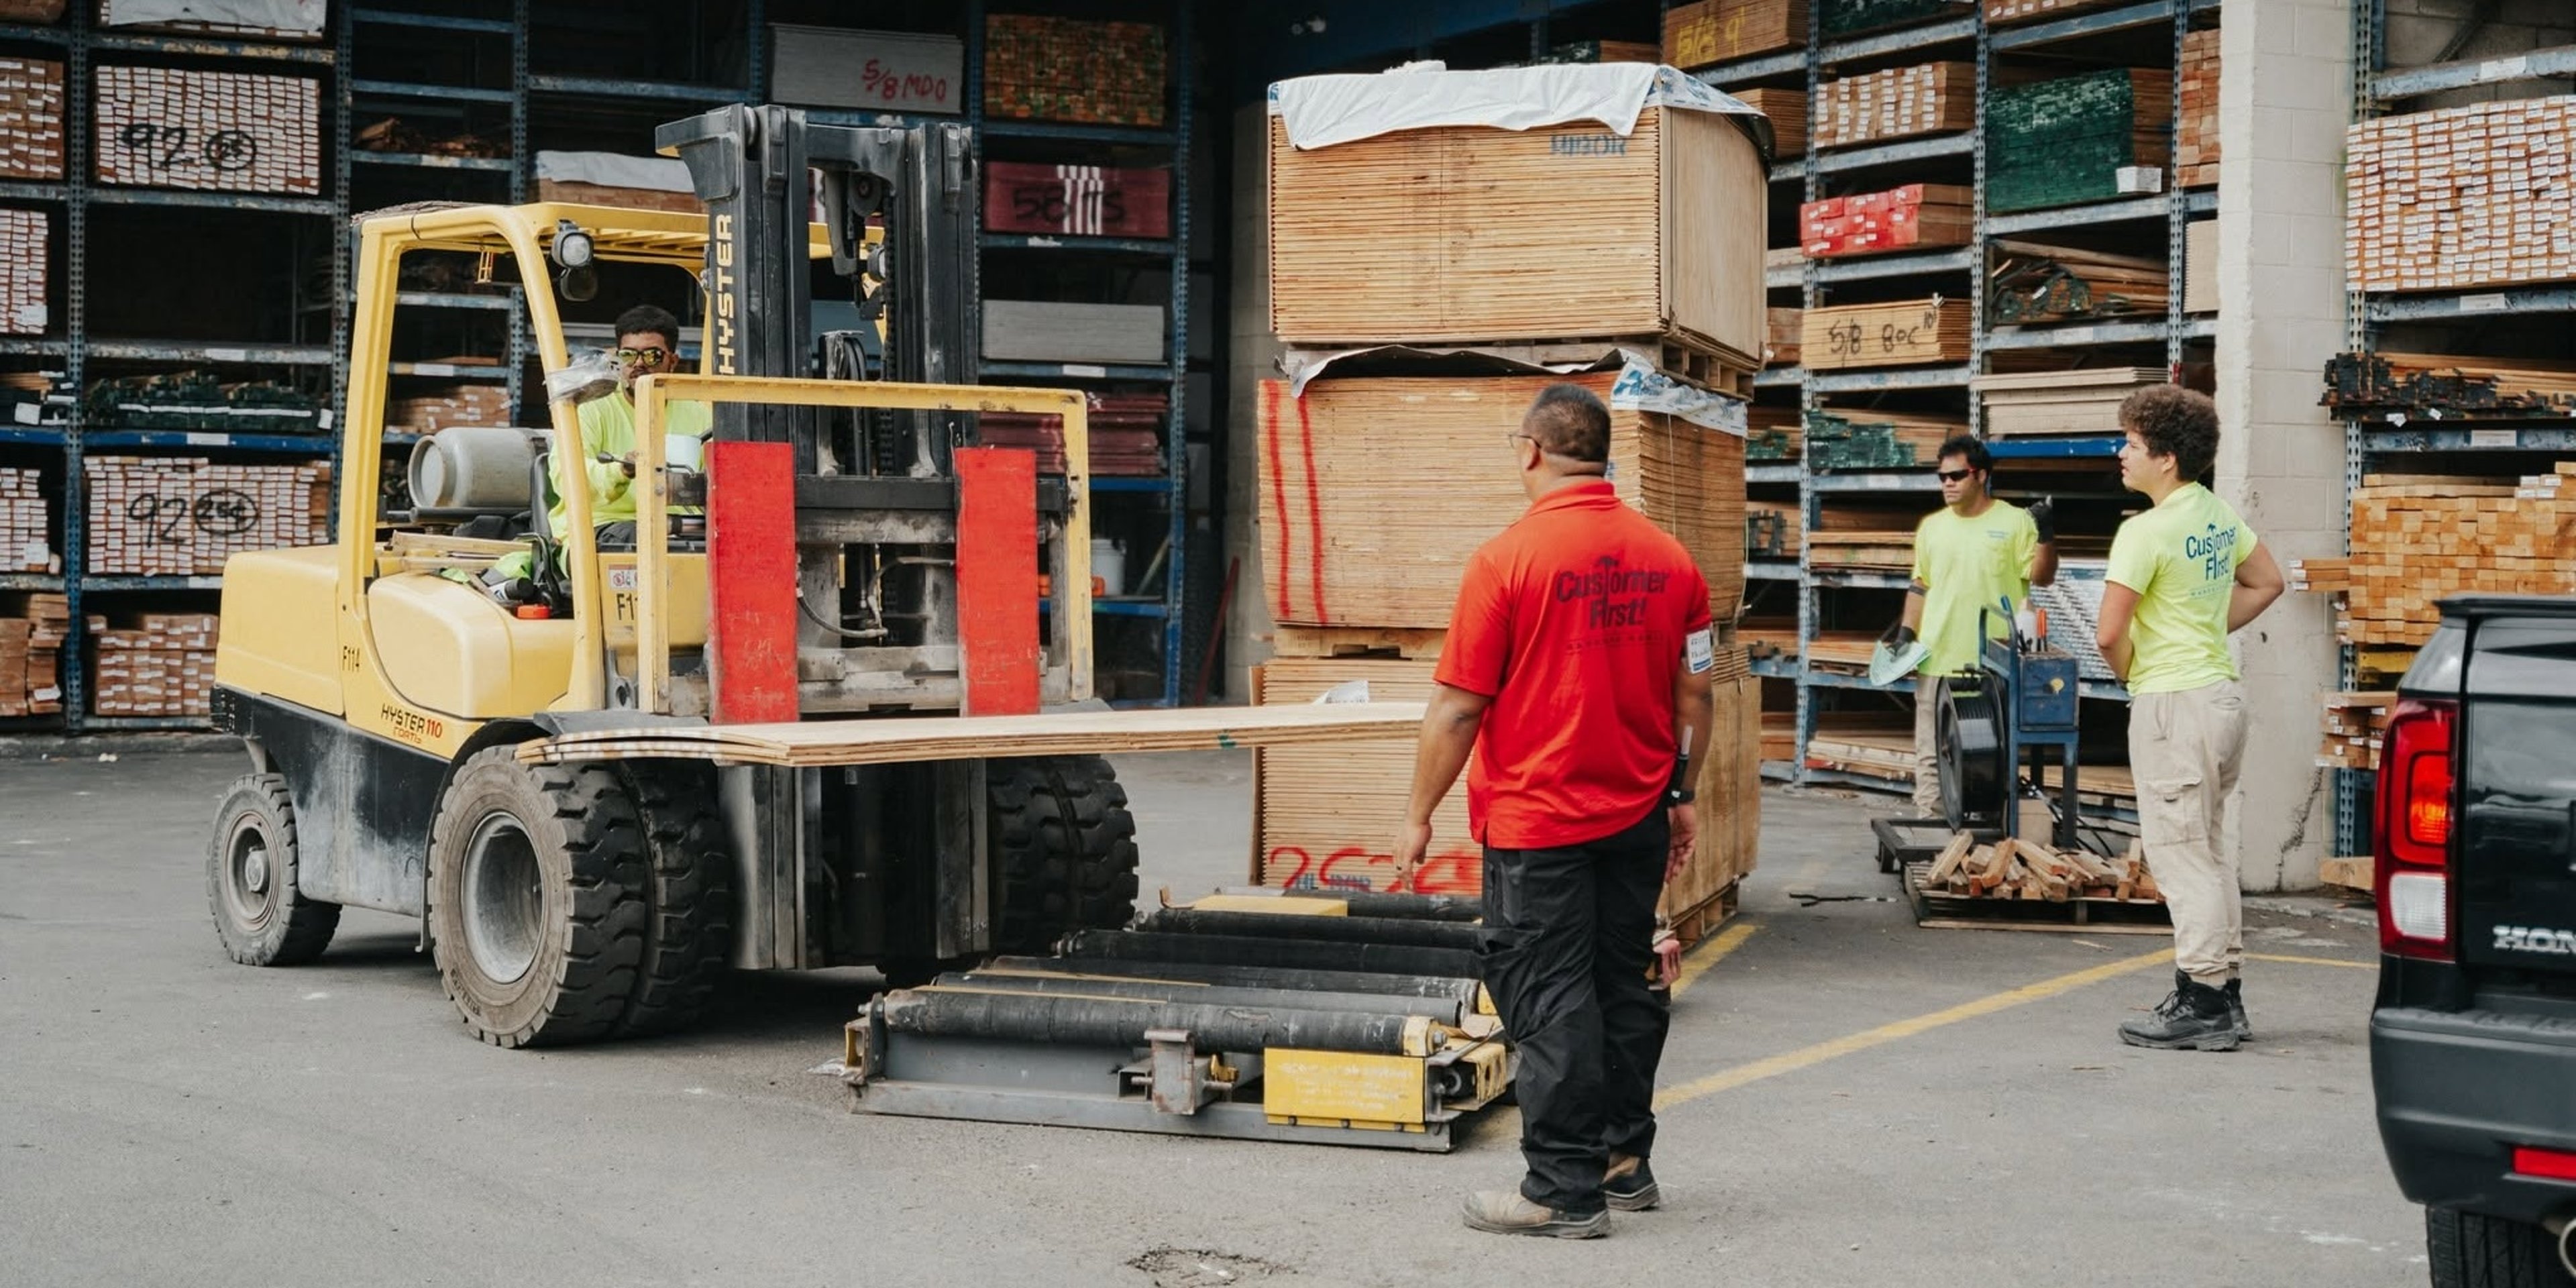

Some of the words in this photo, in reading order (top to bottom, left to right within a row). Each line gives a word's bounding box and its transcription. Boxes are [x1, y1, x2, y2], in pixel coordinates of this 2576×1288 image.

[861, 58, 898, 100] 5/8
[902, 72, 947, 102] MDO
[716, 213, 735, 375] HYSTER
[1828, 317, 1863, 367] 5/8
[128, 492, 187, 548] 92
[1556, 561, 1670, 602] Customer
[616, 593, 638, 621] F1
[380, 703, 425, 735] HYSTER
[426, 718, 443, 739] 110
